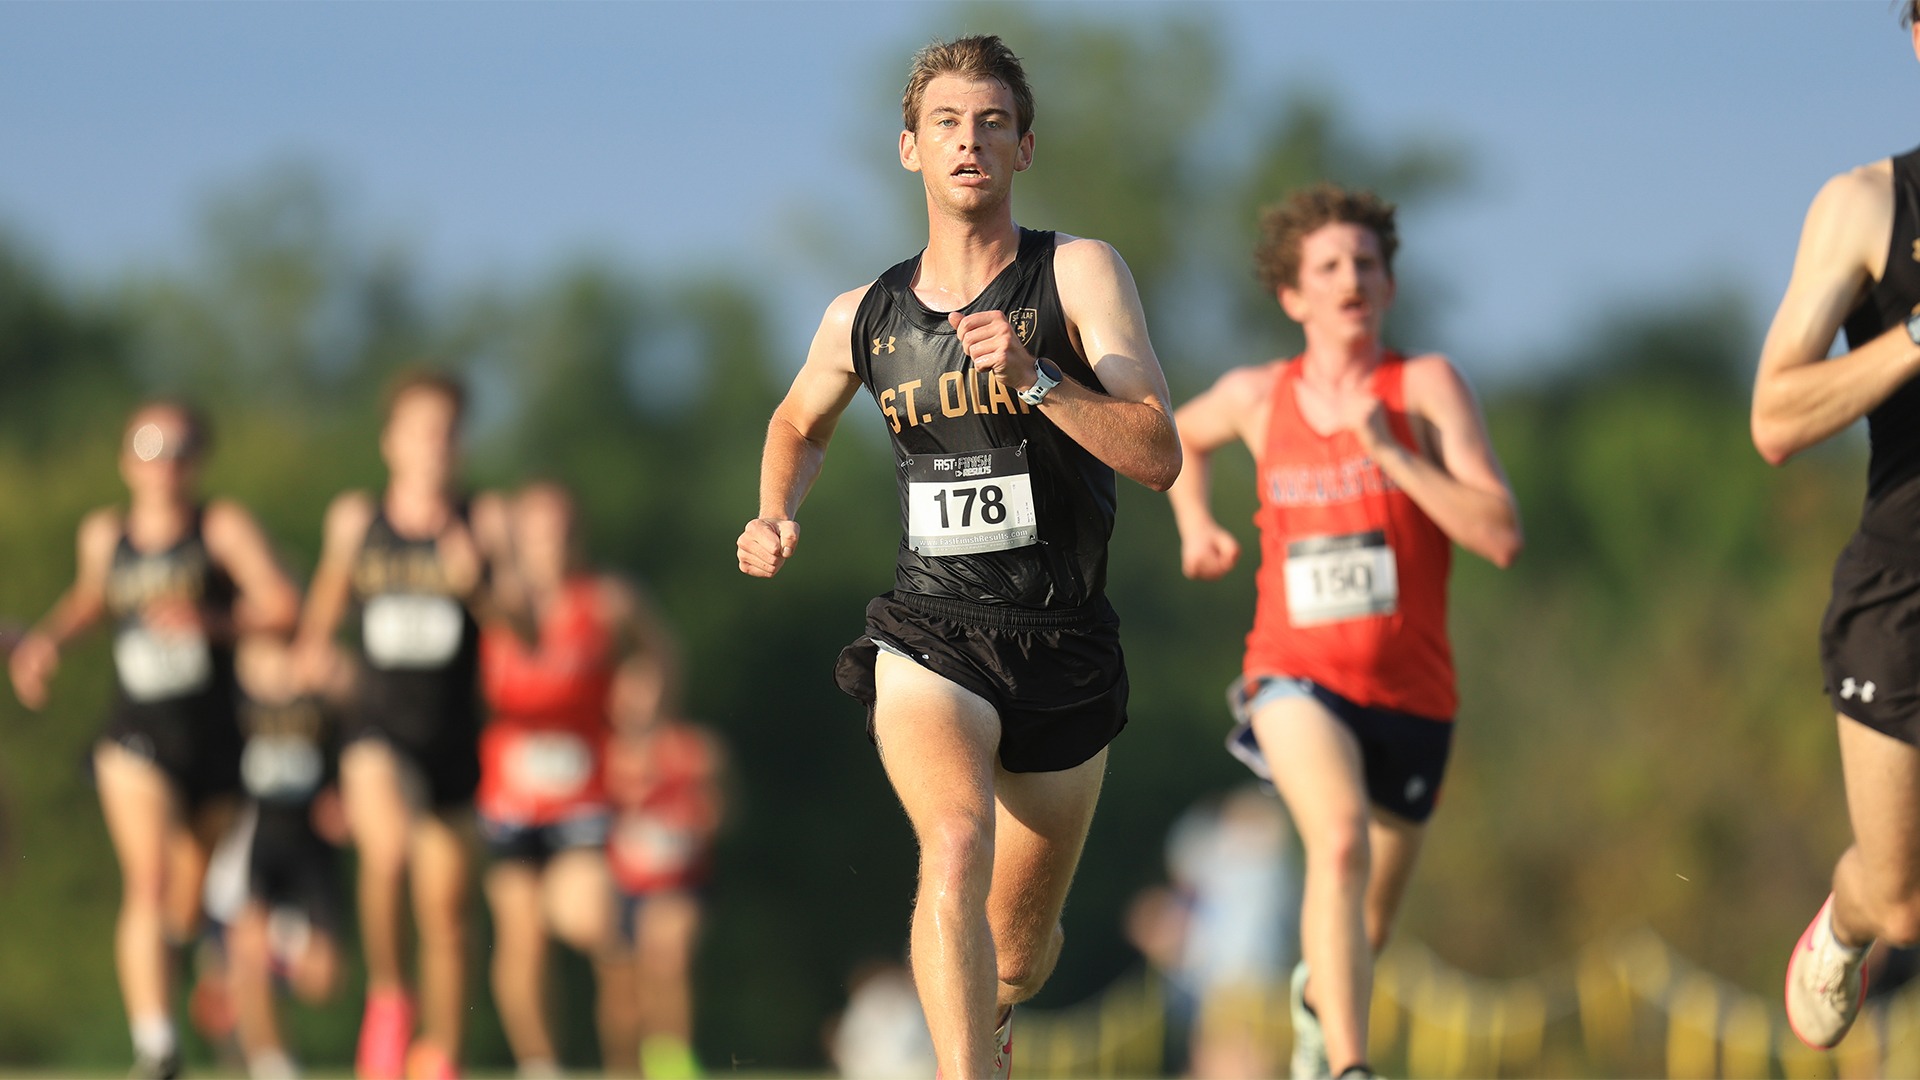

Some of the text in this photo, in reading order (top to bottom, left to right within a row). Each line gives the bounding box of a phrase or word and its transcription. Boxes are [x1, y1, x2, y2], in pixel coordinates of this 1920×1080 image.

[880, 379, 932, 434] ST.
[933, 454, 992, 471] FAST FINISH
[934, 485, 1007, 529] 178
